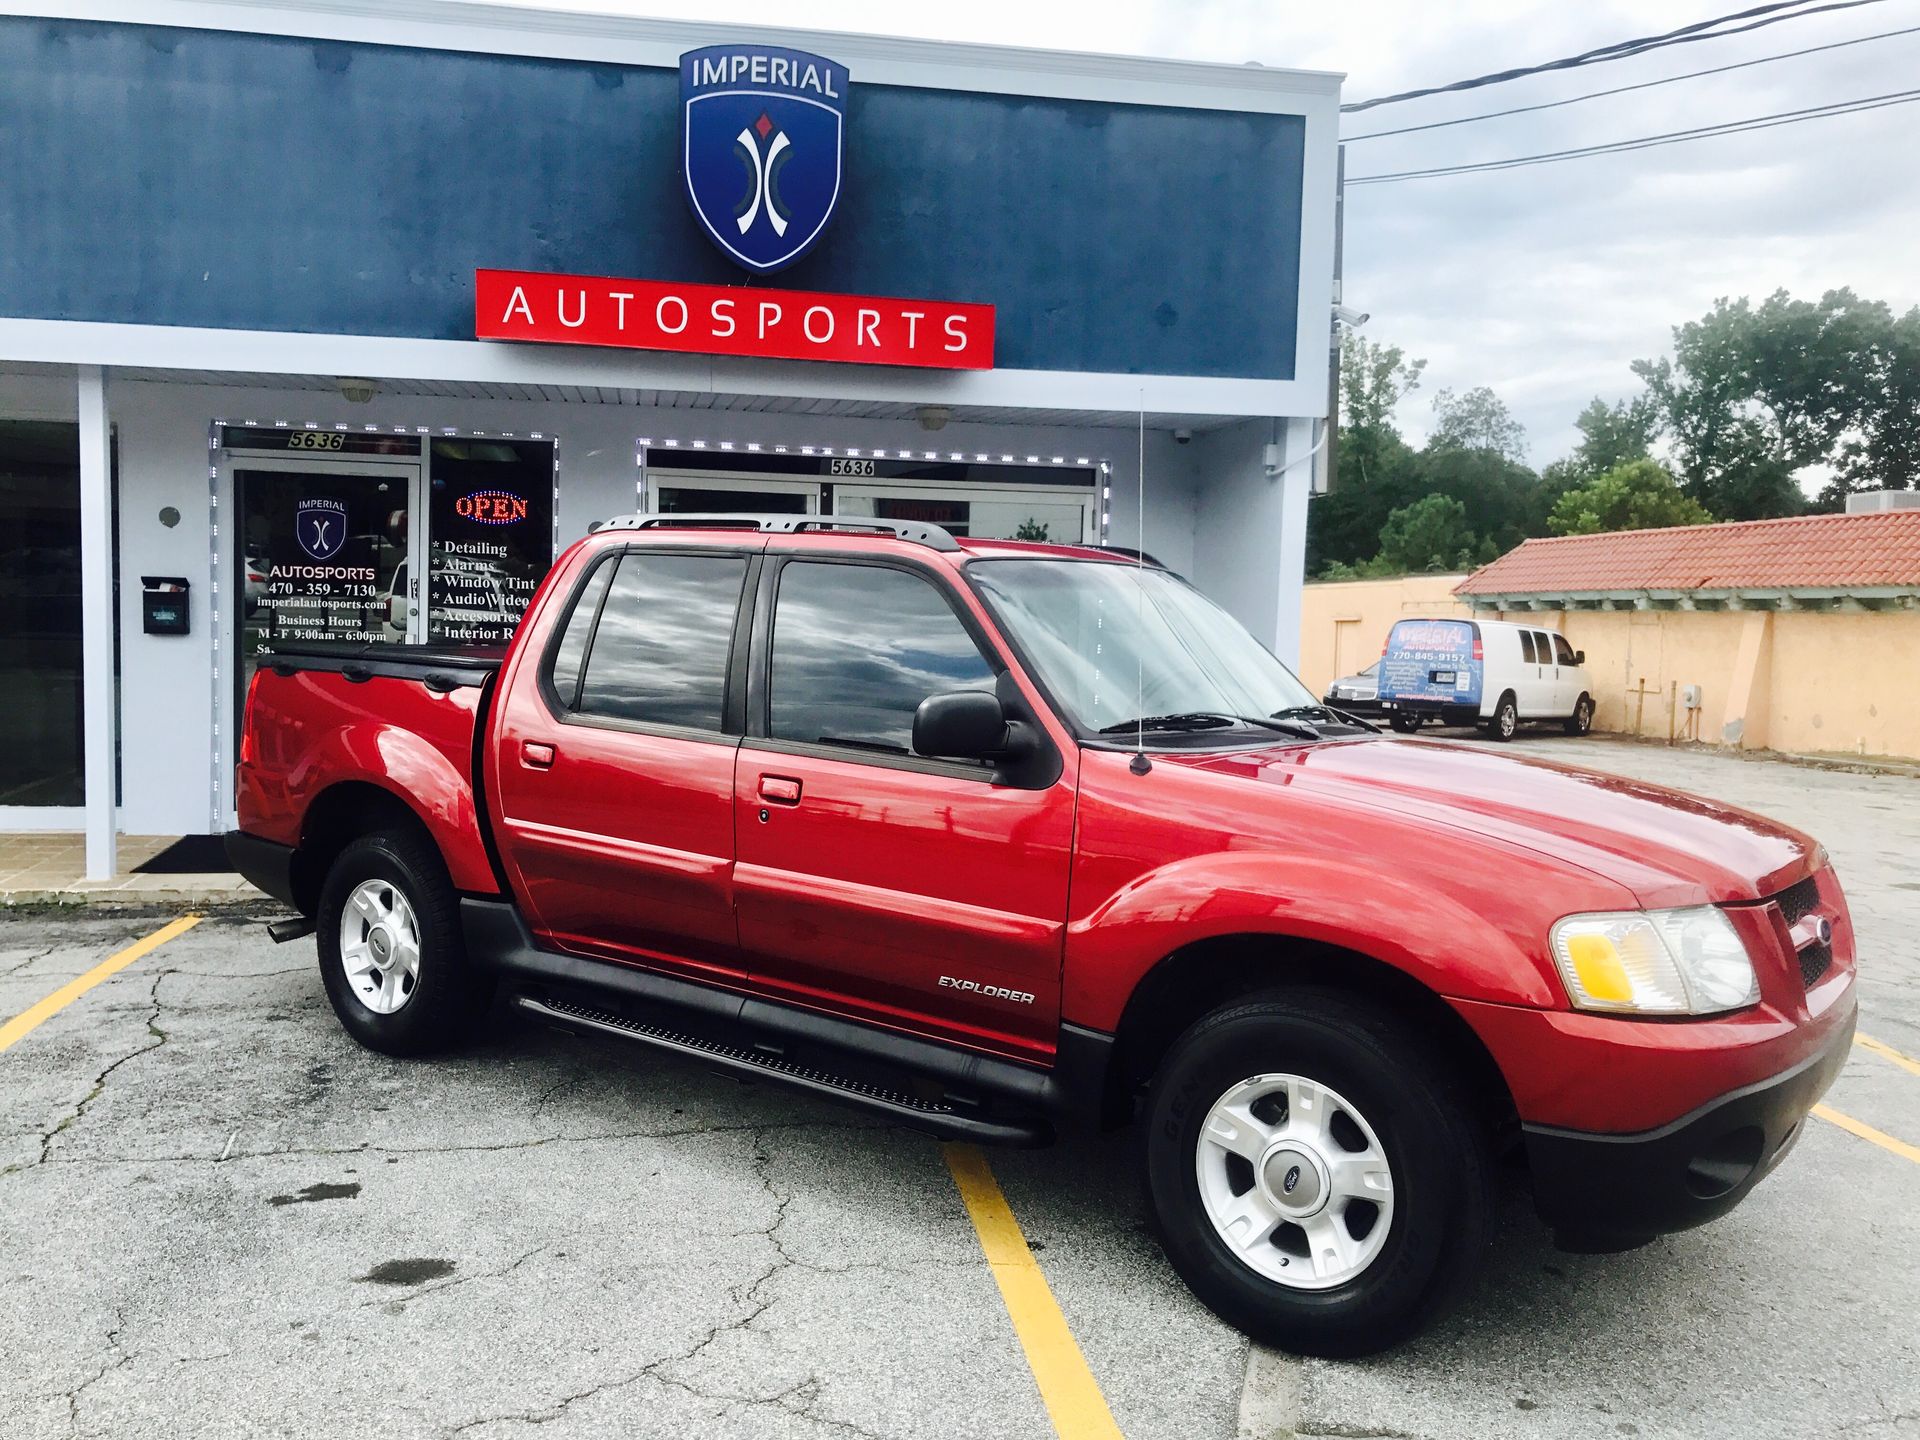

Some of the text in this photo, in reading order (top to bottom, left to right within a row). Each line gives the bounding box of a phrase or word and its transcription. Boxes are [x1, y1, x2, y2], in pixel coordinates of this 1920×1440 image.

[693, 56, 838, 99] IMPERIAL
[502, 285, 969, 352] AUTOSPORTS
[291, 432, 343, 449] 5636
[832, 460, 873, 475] 5636
[298, 499, 345, 511] IMPERIAL
[456, 495, 528, 519] OPEN
[444, 540, 507, 558] Detailing
[443, 558, 495, 571] Alarms
[269, 565, 375, 580] AUTOSPORTS
[268, 582, 293, 595] 470
[306, 583, 331, 596] 359
[344, 584, 376, 597] 7130
[444, 575, 536, 590] Window Tint
[257, 596, 387, 610] imperialautosports.com
[278, 615, 362, 627] Business Hours
[443, 610, 521, 623] Accessories
[294, 629, 335, 640] 9:00am
[345, 630, 387, 643] 6:00pm
[444, 626, 499, 639] Interior
[1393, 651, 1465, 663] 770-845-9157
[937, 975, 1035, 1004] EXPLORER
